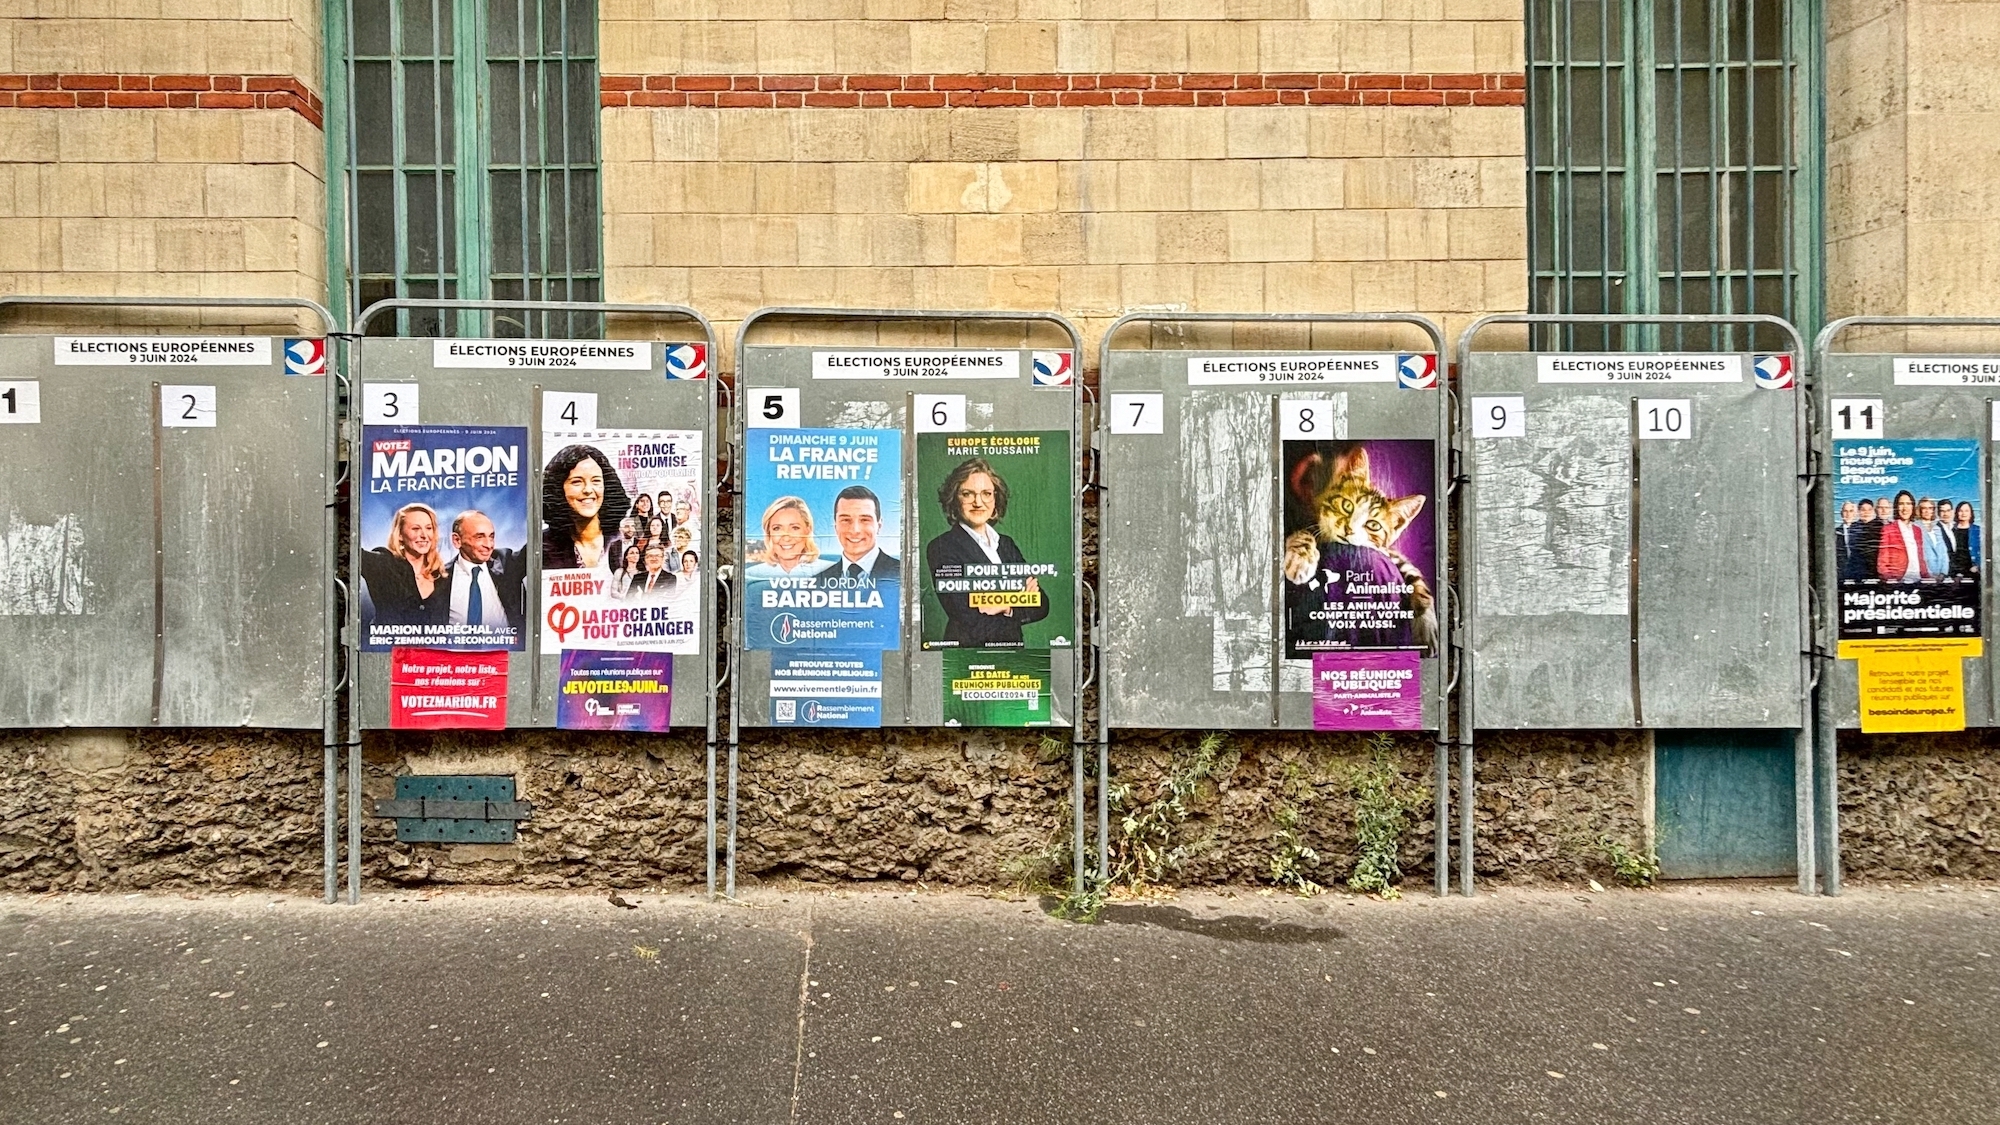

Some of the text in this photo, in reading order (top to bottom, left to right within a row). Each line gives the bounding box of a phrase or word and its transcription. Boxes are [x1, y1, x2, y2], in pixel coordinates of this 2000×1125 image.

[70, 340, 254, 353] ÉLECTIONS EUROPÉENNES
[450, 344, 634, 358] ÉLECTIONS EUROPÉENNES
[130, 354, 198, 363] 9 JUIN 2024
[508, 357, 576, 366] 9 JUIN 2024
[828, 354, 1004, 367] ÉLECTIONS EUROPÉENNES
[1552, 358, 1725, 370] ÉLECTIONS EUROPÉENNES
[1202, 358, 1379, 372] ÉLECTIONS EUROPÉENNES
[1908, 362, 2000, 373] ÉLECTIONS EU
[883, 368, 948, 376] 9 JUIN 2024
[1258, 372, 1324, 381] 9 JUIN 2024
[1607, 372, 1672, 380] 9 JUIN 2024
[2, 388, 16, 413] 1
[182, 394, 198, 419] 2
[382, 392, 399, 418] 3
[560, 400, 578, 426] 4
[762, 395, 784, 420] 5
[932, 402, 948, 426] 6
[1129, 403, 1144, 427] 7
[1298, 408, 1316, 432] 8
[1490, 406, 1507, 430] 9
[1648, 407, 1682, 432] 10
[1838, 405, 1874, 430] 11
[375, 441, 410, 450] VOTEZ
[769, 434, 878, 446] DIMANCHE 9 JUIN
[948, 436, 1040, 446] EUROPE ÉCOLOGIE
[627, 443, 676, 456] FRANCE
[769, 447, 878, 463] LA FRANCE
[948, 445, 1040, 456] MARIE TOUSSAINT
[1840, 446, 1896, 458] Le 9 juin,
[372, 446, 518, 478] MARION
[1840, 456, 1914, 466] nous avons
[776, 464, 872, 480] REVIENT !
[1840, 465, 1884, 474] Besoin
[370, 471, 518, 493] LA FRANCE FIÈRE
[1840, 475, 1898, 486] d'Europe
[564, 572, 592, 581] MANON
[966, 564, 999, 576] POUR
[1002, 564, 1058, 577] L'EUROPE,
[1346, 570, 1374, 582] Parti
[550, 580, 604, 597] AUBRY
[769, 577, 876, 589] VOTEZ JORDAN
[938, 579, 1026, 592] POUR NOS VIES,
[1346, 582, 1414, 594] Animaliste
[762, 590, 884, 608] BARDELLA
[1844, 589, 1922, 608] Majorité
[1323, 602, 1400, 610] LES ANIMAUX
[582, 606, 669, 624] LA FORCE DE
[1308, 610, 1414, 621] COMPTENT, VOTRE
[1844, 604, 1975, 624] présidentielle
[370, 624, 422, 635] MARION
[424, 622, 492, 634] MARÉCHAL
[793, 618, 874, 628] Rassemblement
[1328, 620, 1396, 629] VOIX AUSSI.
[582, 620, 694, 640] TOUT CHANGER
[793, 630, 837, 639] National
[370, 635, 394, 645] ÉRIC
[394, 636, 447, 645] ZEMMOUR
[402, 663, 498, 676] Notre projet, notre liste,
[789, 660, 864, 668] RETROUVEZ TOUTES
[570, 668, 590, 676] Toutes
[600, 668, 626, 676] réunions
[626, 668, 652, 678] publiques
[792, 668, 832, 676] RÉUNIONS
[970, 670, 1010, 679] LES DATES
[1320, 668, 1414, 681] NOS RÉUNIONS
[414, 676, 480, 686] nos réunions sur
[996, 680, 1040, 690] PUBLIQUES
[1332, 680, 1402, 692] PUBLIQUES
[774, 684, 878, 694] www.vivementle9juin.fr
[401, 695, 497, 709] VOTEZMARION.FR
[816, 704, 874, 712] Rassemblement
[816, 712, 848, 720] National
[1868, 707, 1956, 716] besoindeurope.fr
